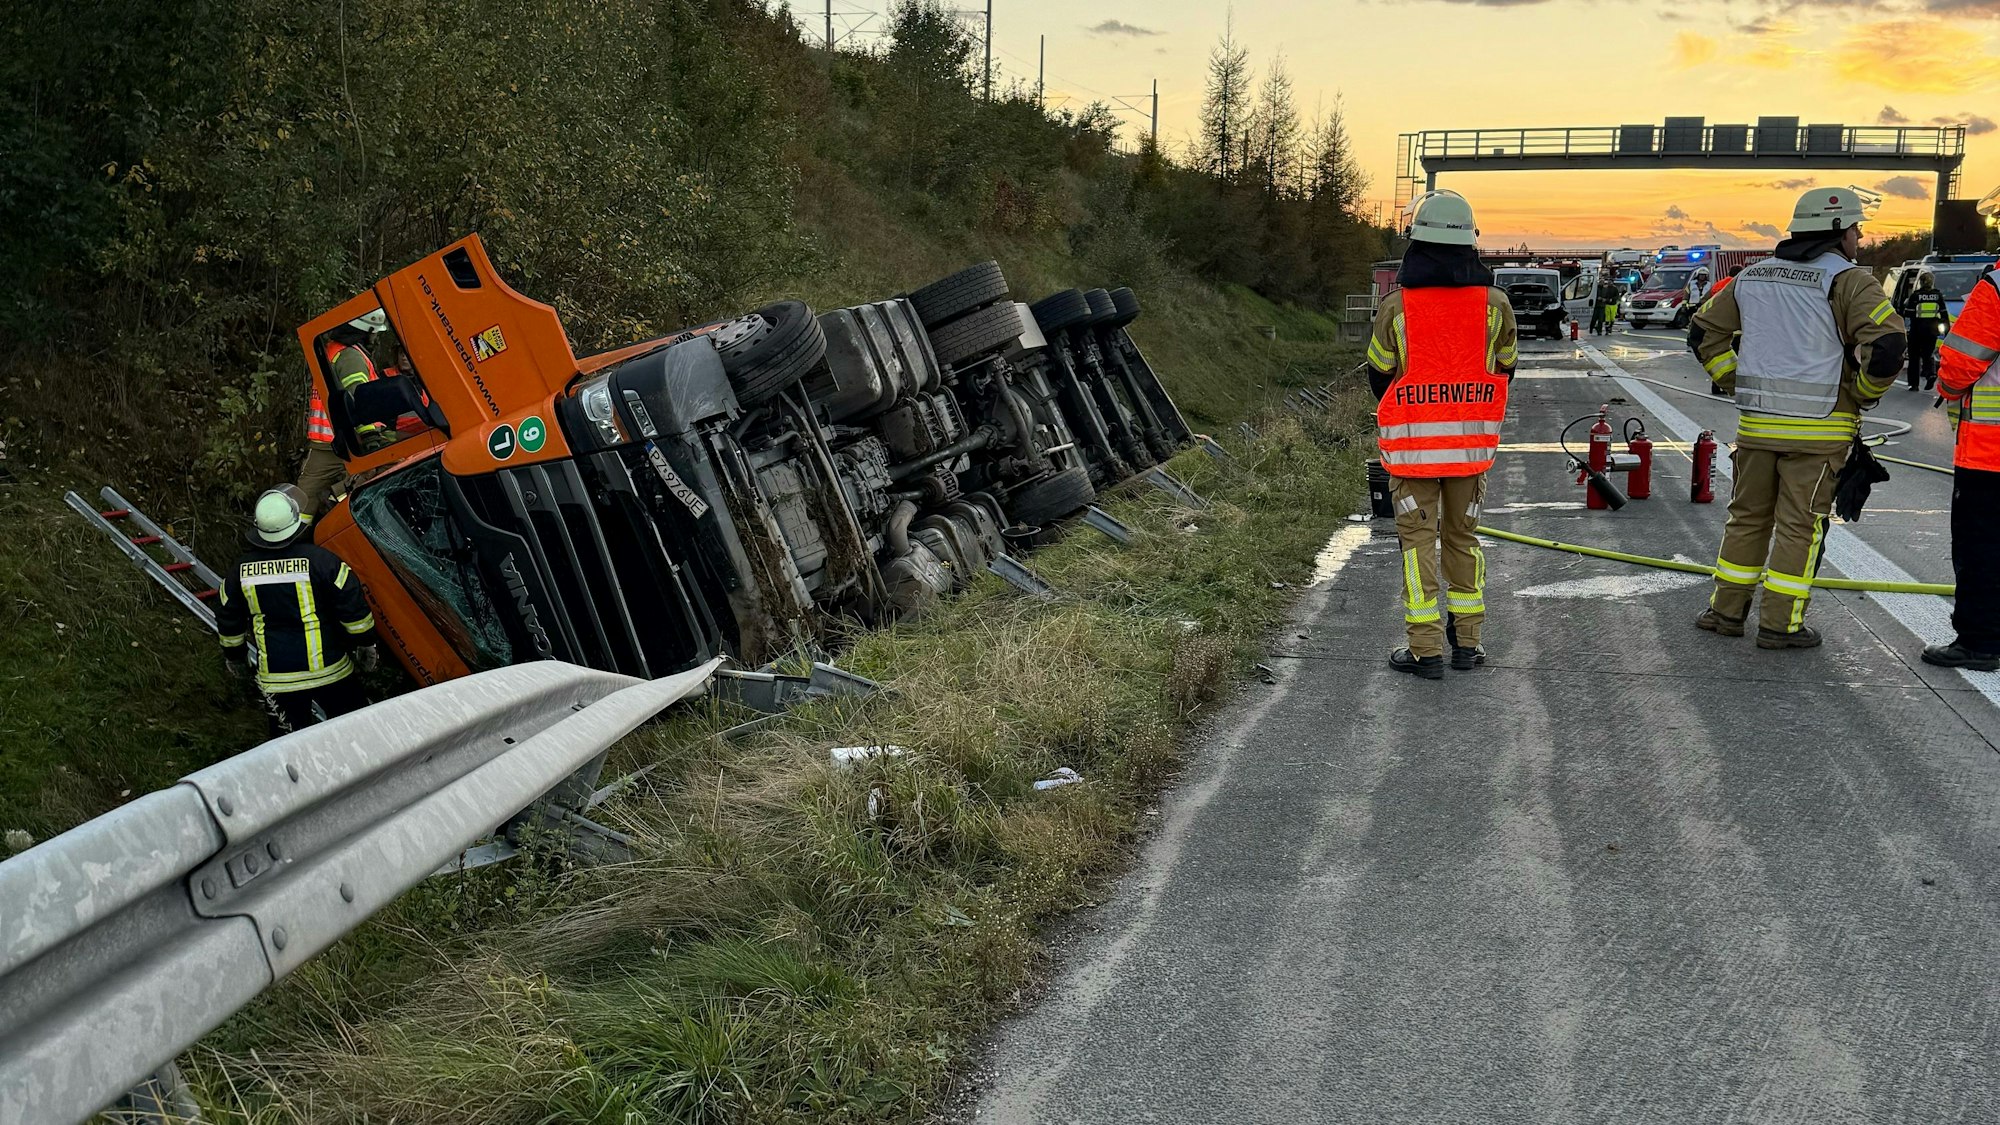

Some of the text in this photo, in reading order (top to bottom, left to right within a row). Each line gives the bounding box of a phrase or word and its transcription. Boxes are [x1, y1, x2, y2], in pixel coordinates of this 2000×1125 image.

[1744, 266, 1820, 283] ABSCHNITTSLEITER 3
[417, 273, 500, 417] www.spartank.eu
[1395, 382, 1495, 406] FEUERWEHR
[494, 431, 511, 451] L
[523, 426, 540, 442] 6
[650, 450, 704, 515] PZ 976UE
[240, 558, 308, 578] FEUERWEHR
[500, 552, 557, 660] CANIA
